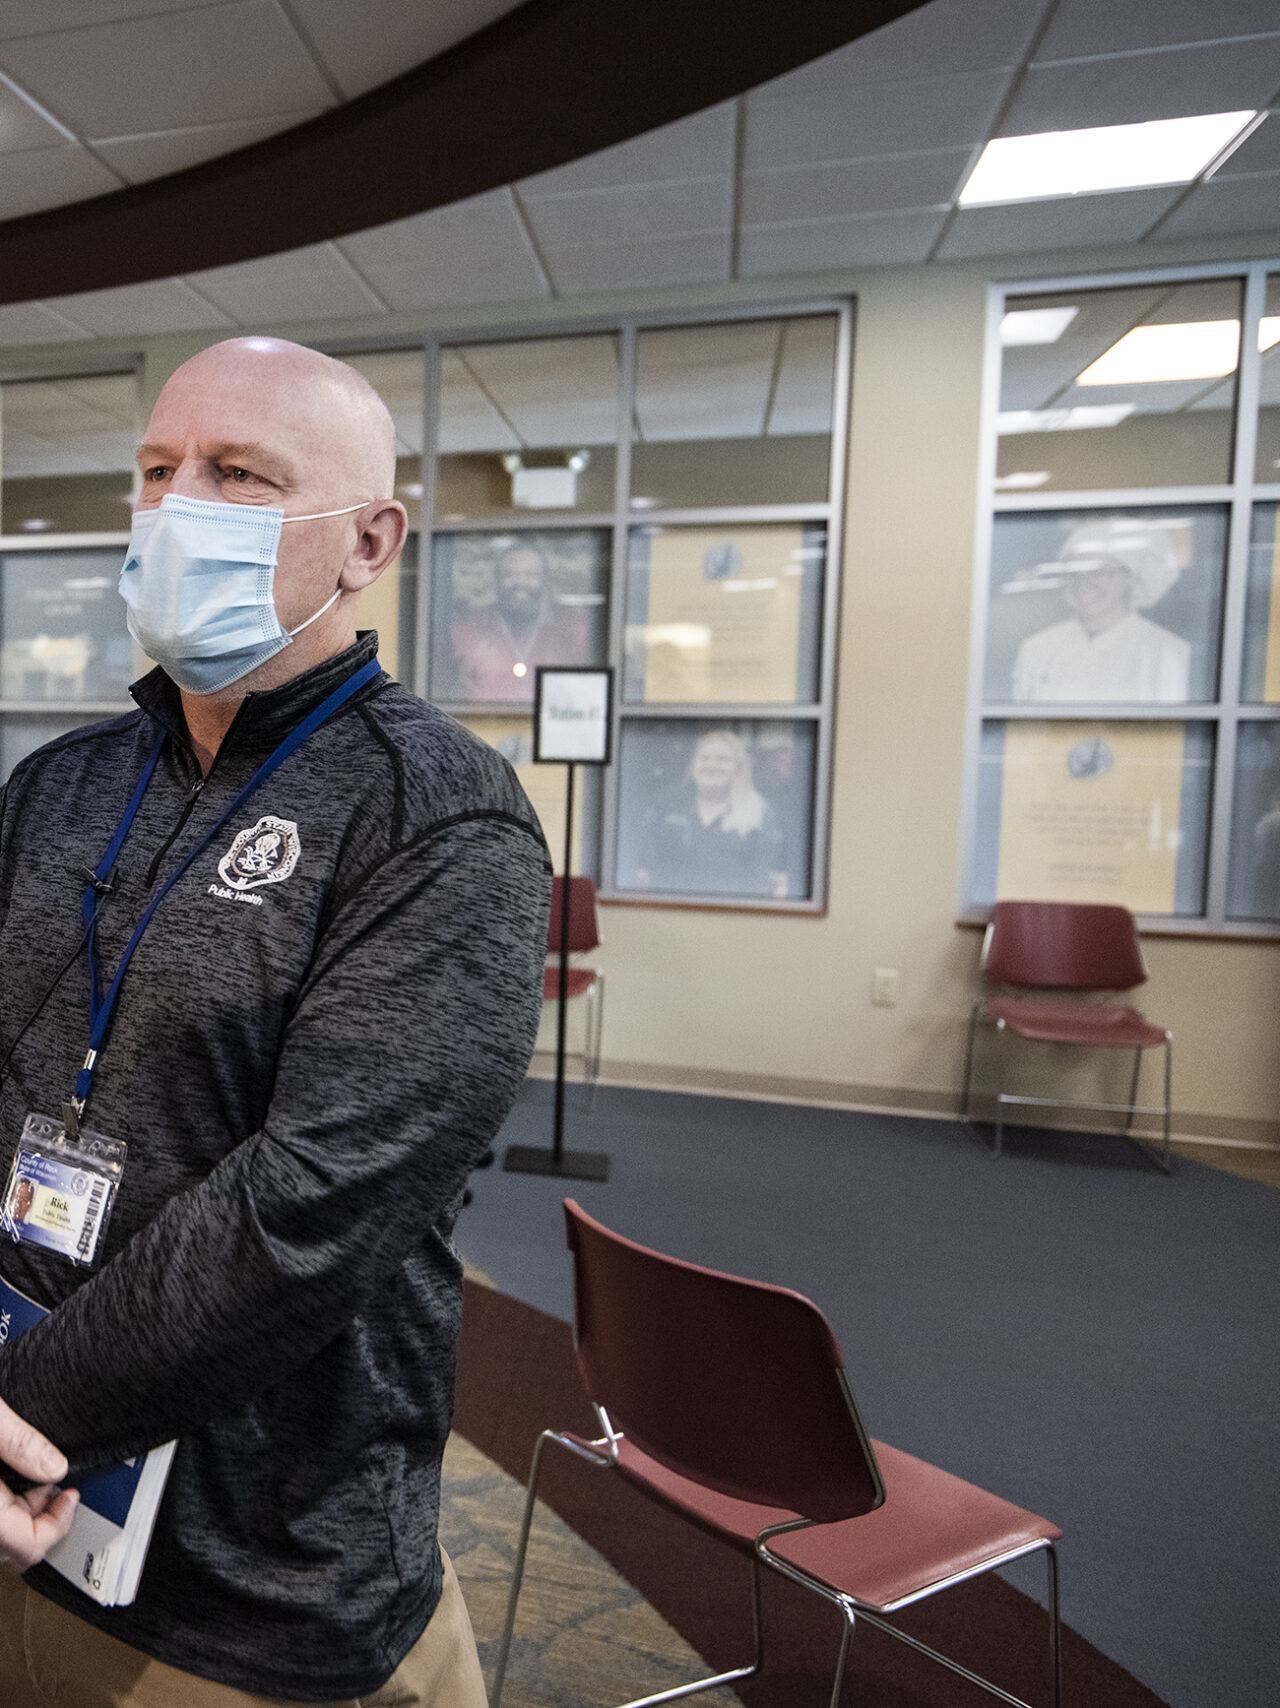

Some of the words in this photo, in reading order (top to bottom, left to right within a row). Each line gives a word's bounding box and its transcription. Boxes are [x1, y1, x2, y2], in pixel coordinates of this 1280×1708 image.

[208, 884, 234, 900] Public
[234, 890, 263, 906] Health
[50, 1197, 69, 1211] Rick
